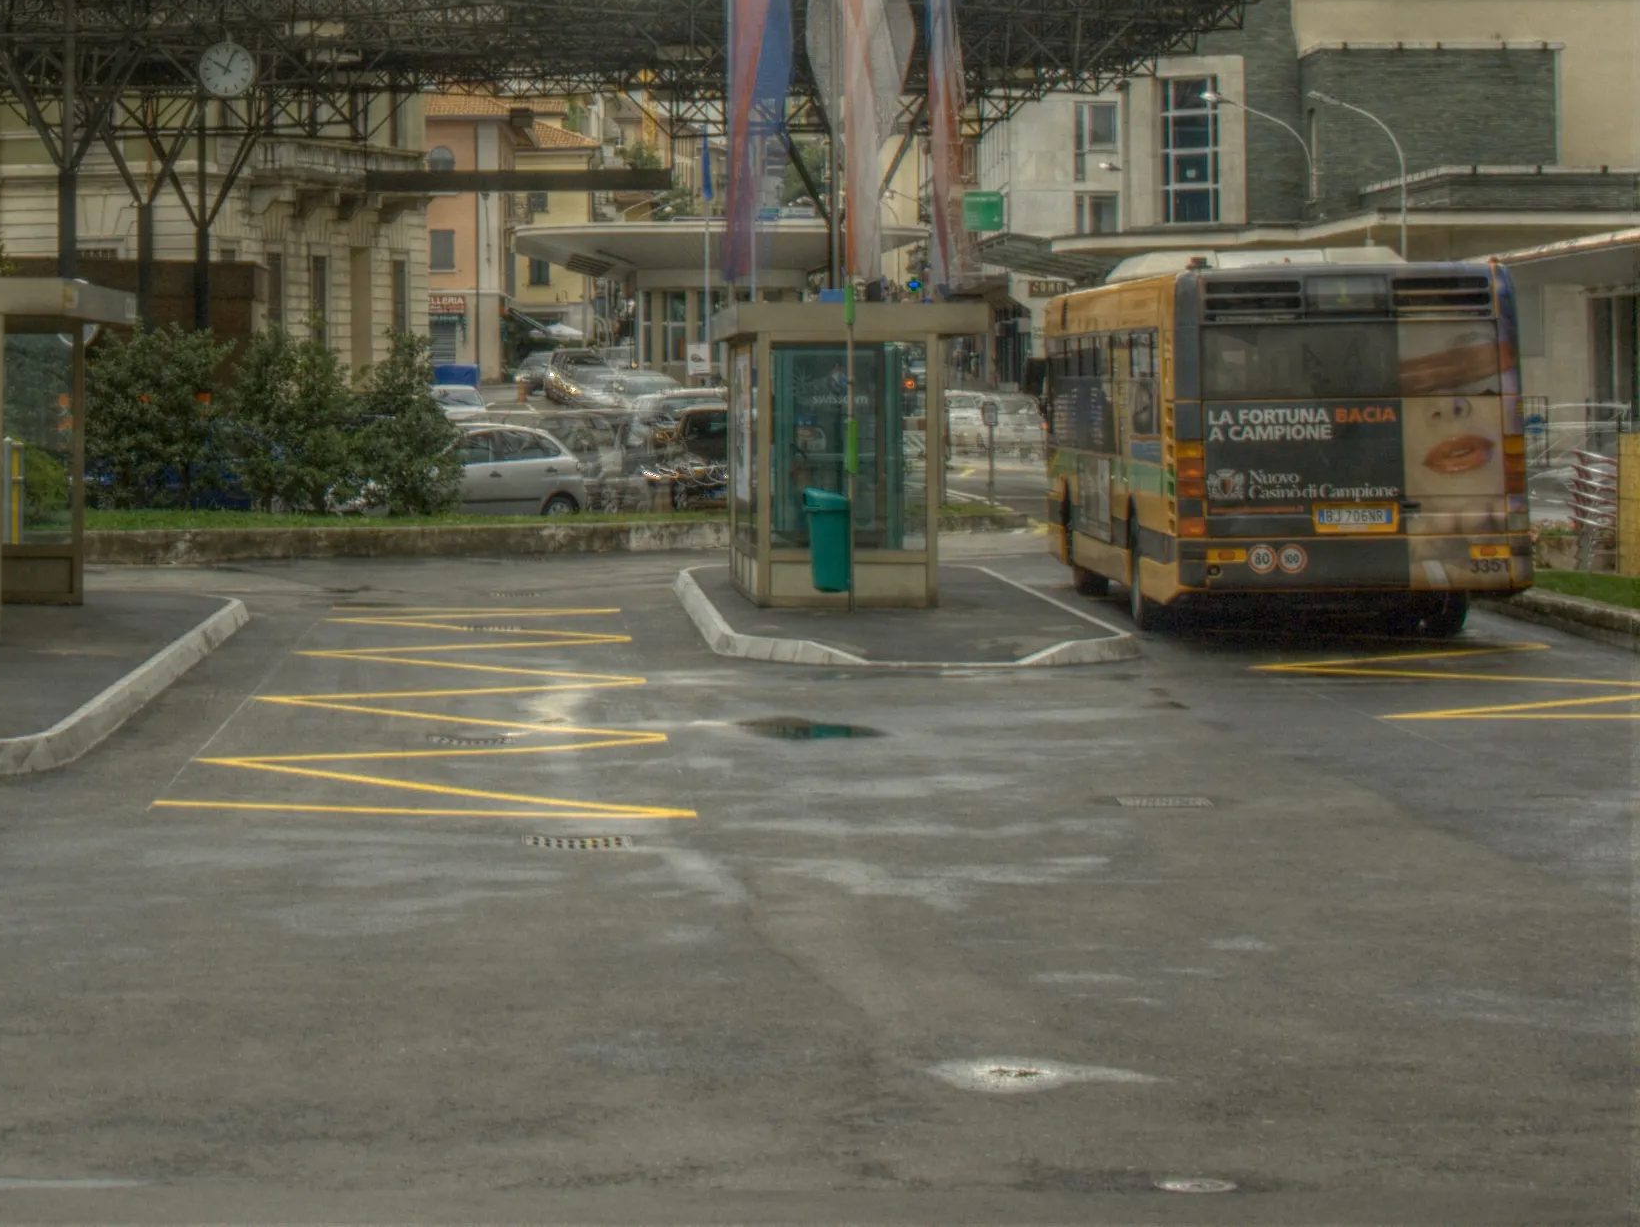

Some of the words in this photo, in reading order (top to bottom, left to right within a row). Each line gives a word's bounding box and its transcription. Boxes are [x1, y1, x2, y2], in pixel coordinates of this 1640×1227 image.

[1208, 408, 1234, 425] LA
[1238, 407, 1330, 425] FORTUNA
[1335, 405, 1397, 423] BACIA
[1209, 425, 1225, 442] A
[1228, 424, 1333, 441] CAMPIONE
[1248, 469, 1300, 485] Nuovo
[1248, 484, 1302, 500] Casinò
[1302, 484, 1317, 499] di
[1319, 482, 1400, 502] Campione
[1255, 552, 1270, 565] 80
[1284, 553, 1300, 564] 100
